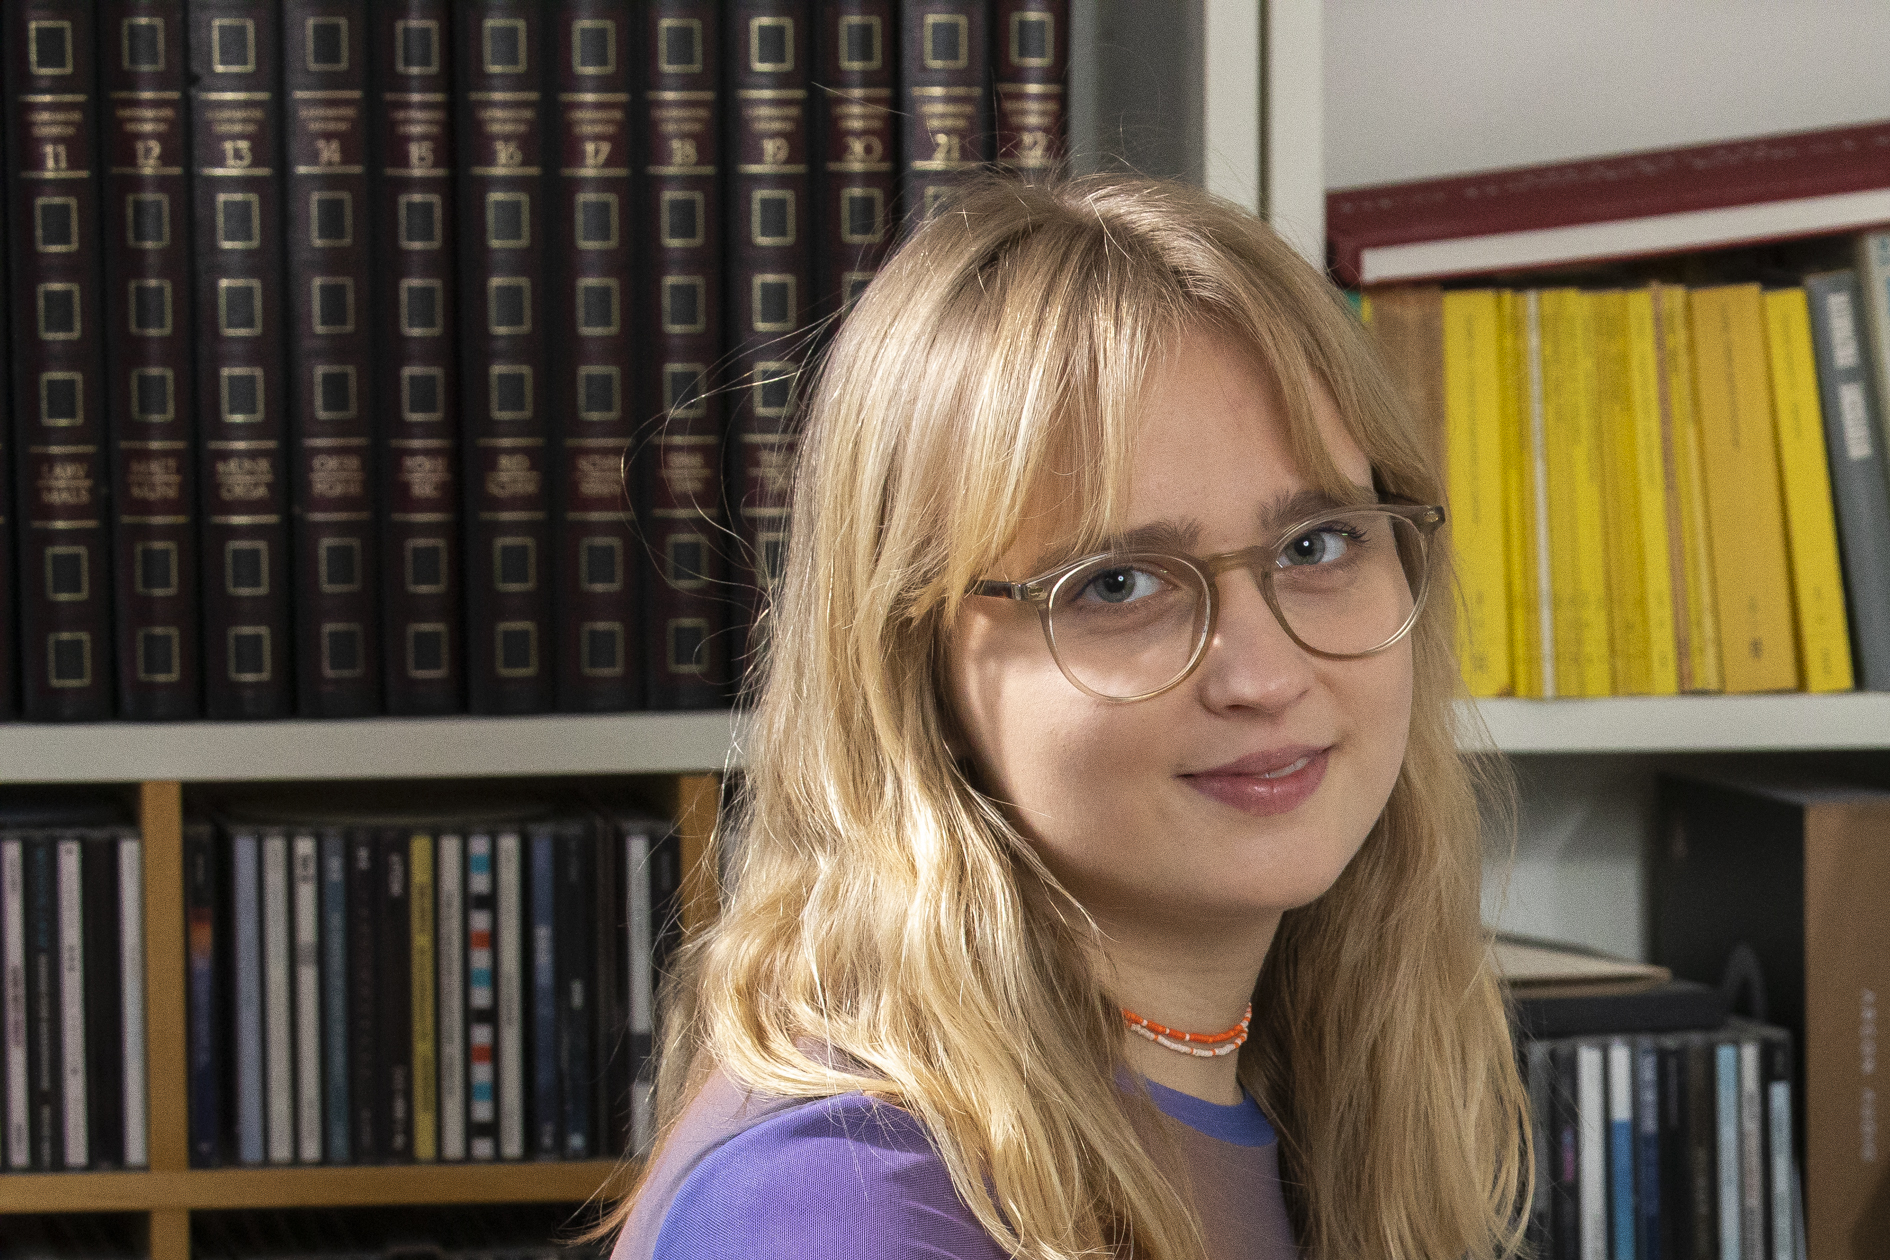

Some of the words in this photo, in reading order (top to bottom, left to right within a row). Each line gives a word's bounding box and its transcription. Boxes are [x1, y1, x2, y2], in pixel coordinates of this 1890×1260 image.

[43, 144, 67, 169] 11
[135, 140, 161, 168] 12
[222, 140, 252, 169] 13
